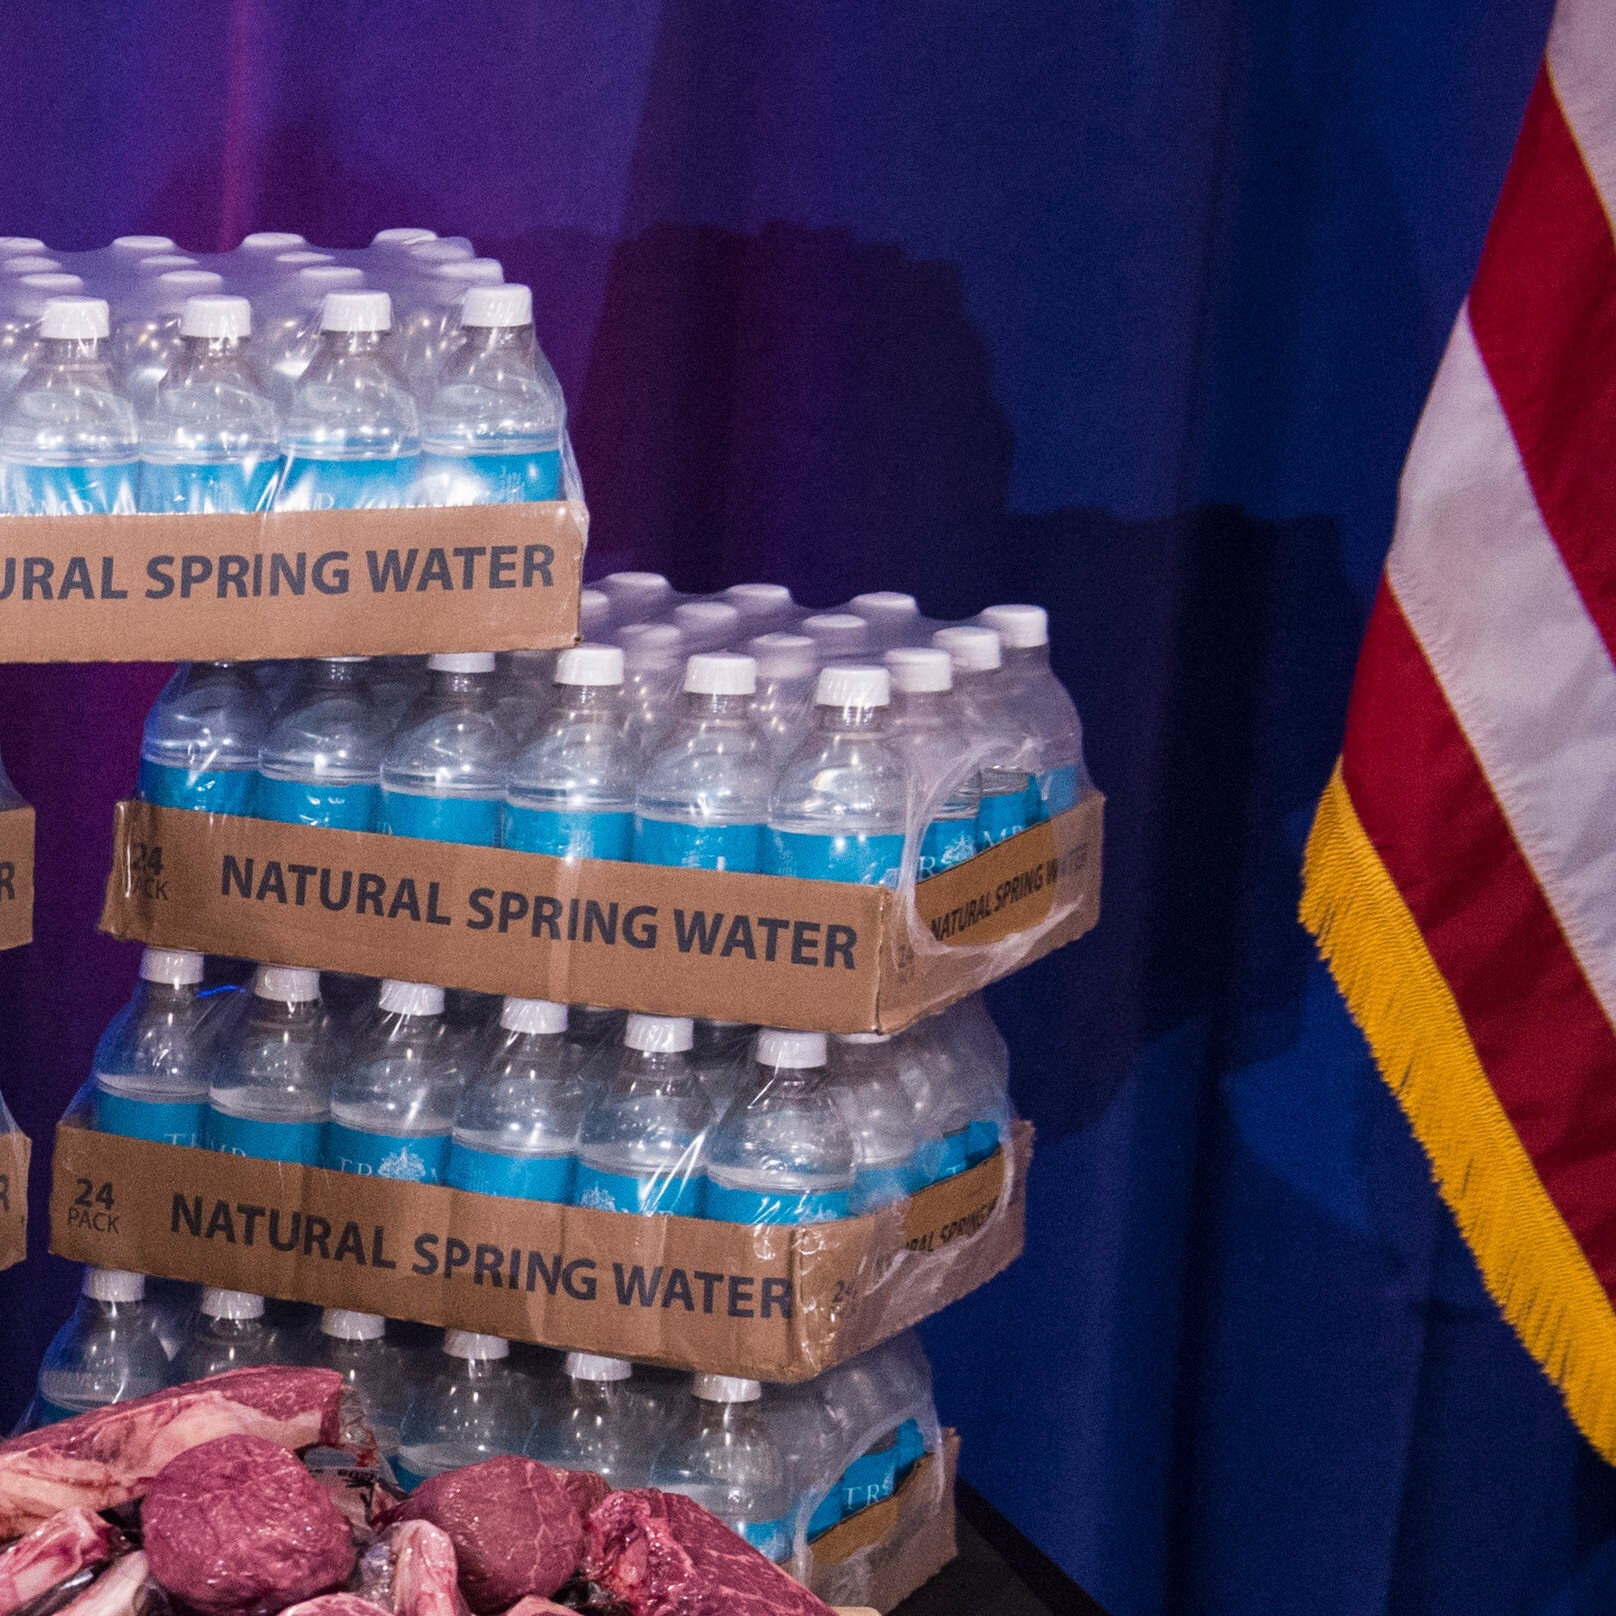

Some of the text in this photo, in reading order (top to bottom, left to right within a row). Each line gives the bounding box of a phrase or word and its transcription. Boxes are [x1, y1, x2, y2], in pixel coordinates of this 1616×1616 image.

[145, 551, 350, 600] SPRING
[366, 544, 555, 593] WATER
[221, 854, 452, 926] NATURAL
[467, 887, 659, 950] SPRING
[673, 909, 858, 971] WATER
[930, 891, 992, 942] NATURAL
[994, 863, 1044, 912] SPRING
[67, 1206, 120, 1235] PACK
[74, 1177, 115, 1211] 24
[169, 1192, 793, 1319] NATURAL SPRING WATER
